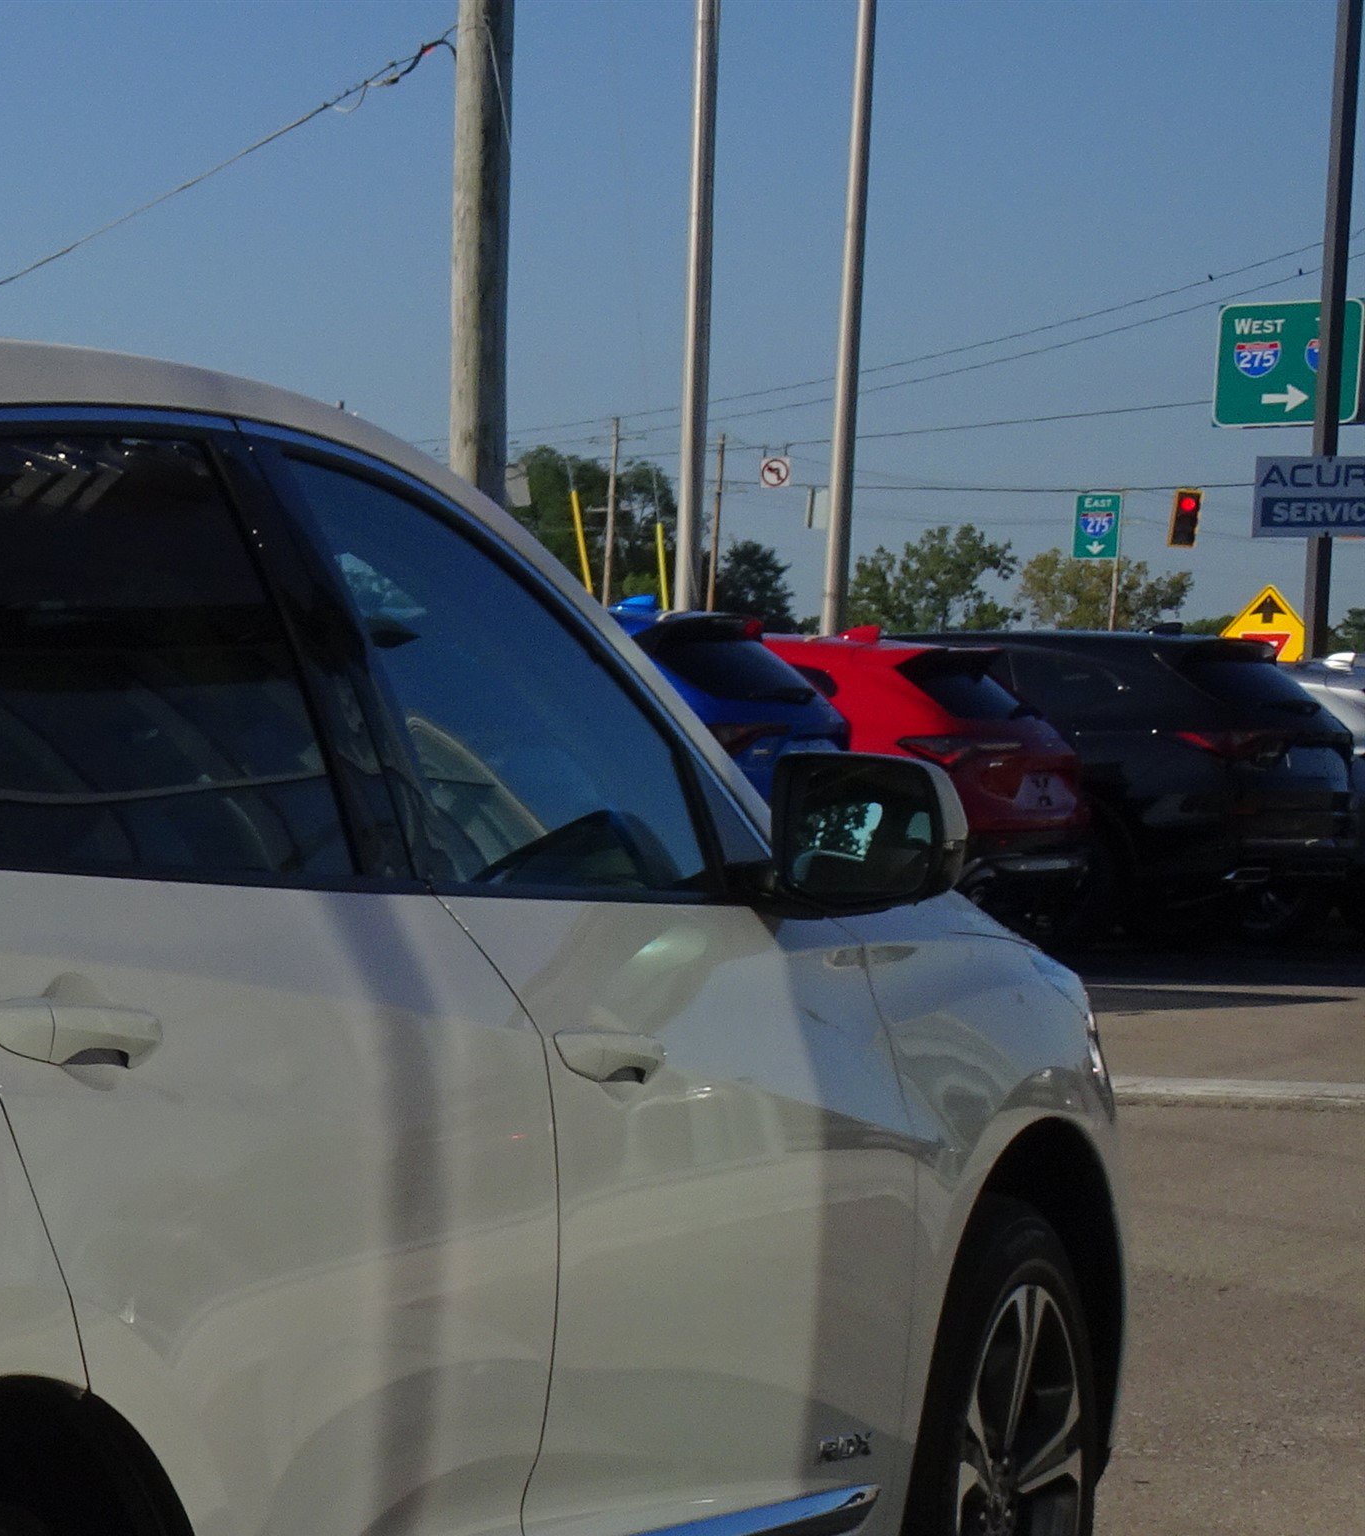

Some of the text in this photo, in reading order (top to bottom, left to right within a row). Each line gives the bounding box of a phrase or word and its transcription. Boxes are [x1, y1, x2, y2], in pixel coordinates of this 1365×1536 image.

[1235, 318, 1285, 335] WEST
[1239, 351, 1275, 368] 275
[1084, 497, 1112, 508] EAST
[1087, 518, 1109, 532] 275
